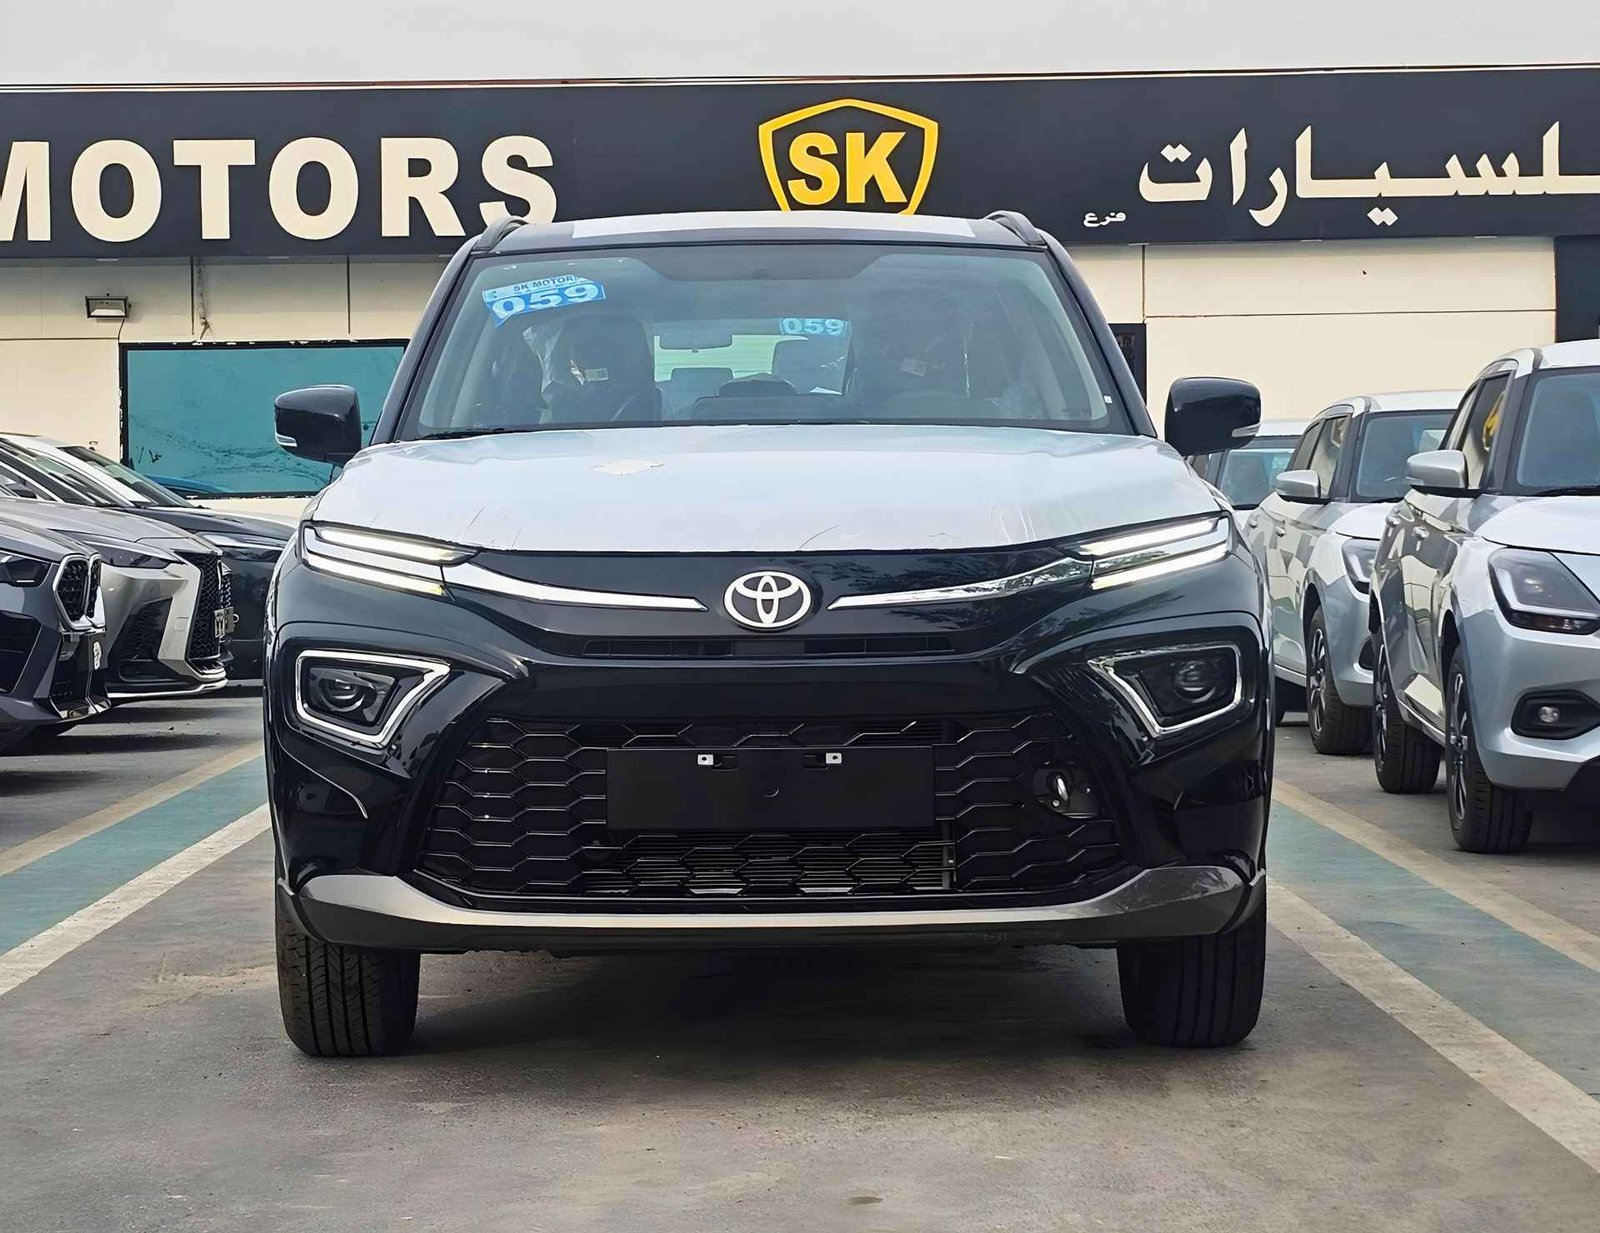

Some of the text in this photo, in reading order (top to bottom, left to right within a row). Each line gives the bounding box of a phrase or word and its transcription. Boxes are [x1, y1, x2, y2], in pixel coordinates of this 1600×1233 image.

[787, 131, 908, 206] SK
[1138, 120, 1600, 227] لسيارات
[491, 283, 600, 319] 059
[782, 318, 845, 335] 059
